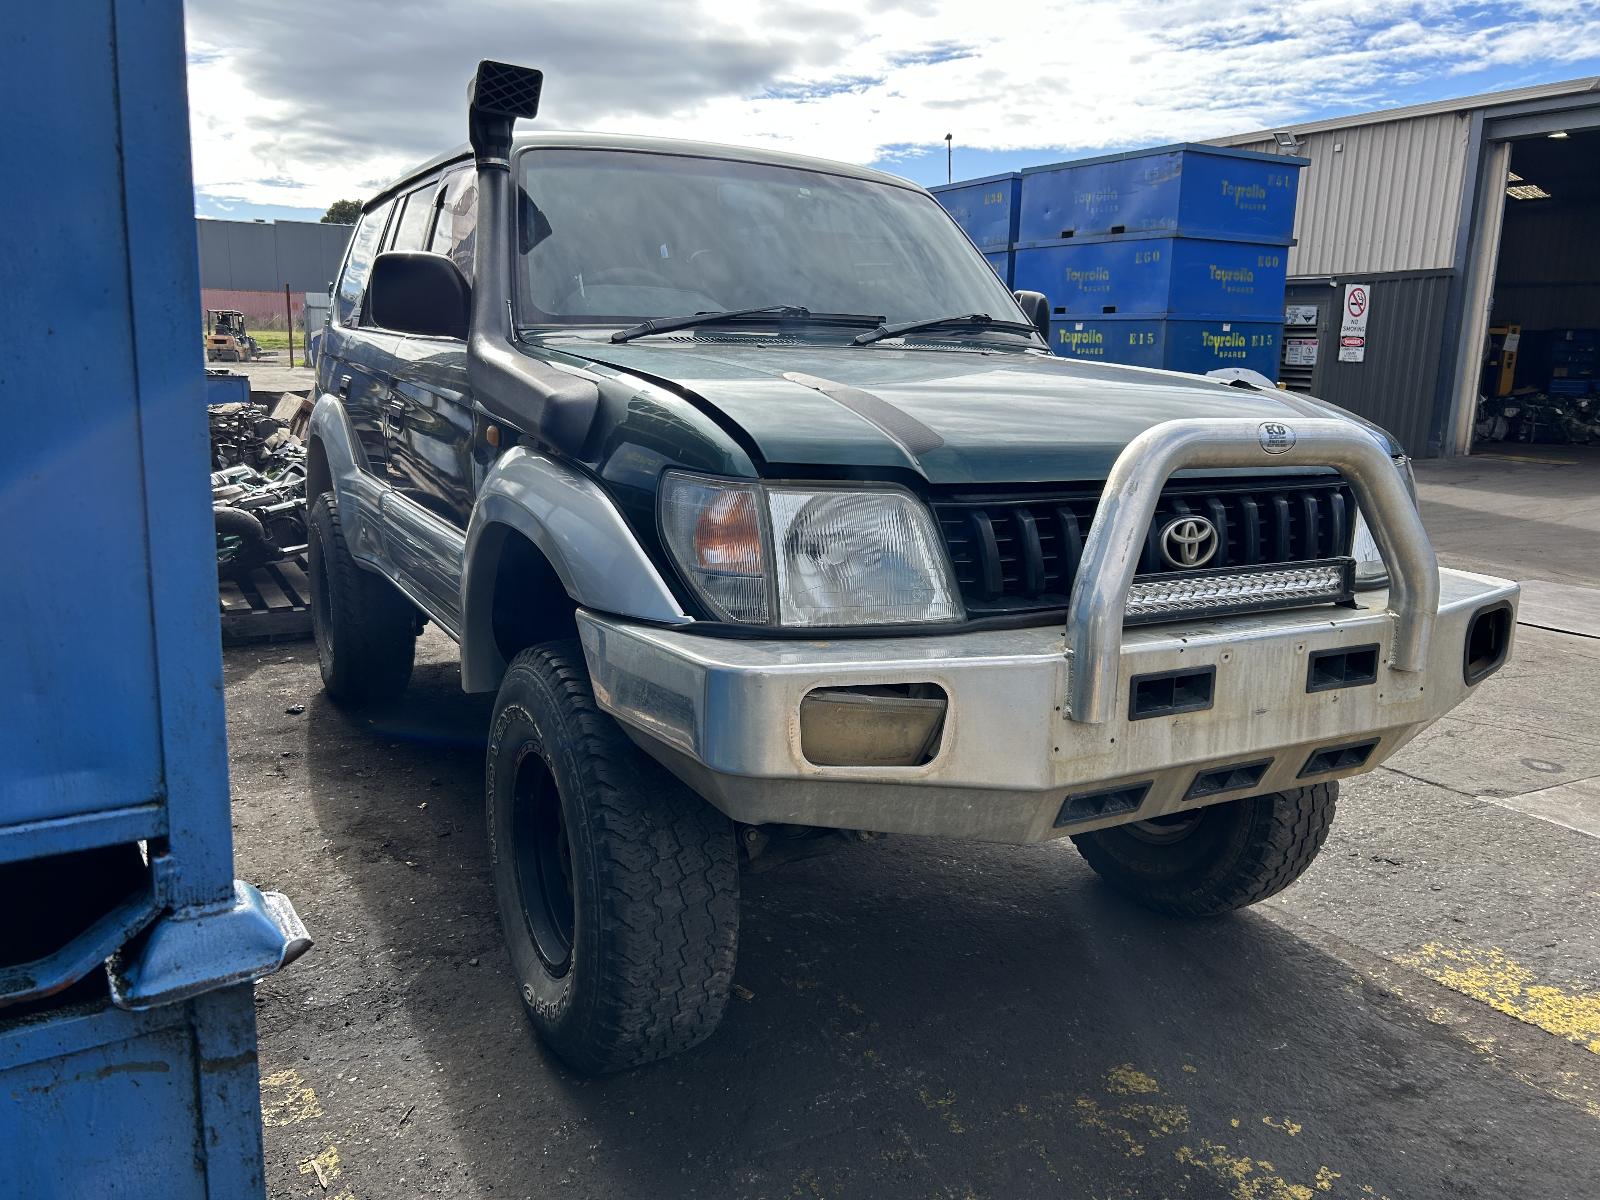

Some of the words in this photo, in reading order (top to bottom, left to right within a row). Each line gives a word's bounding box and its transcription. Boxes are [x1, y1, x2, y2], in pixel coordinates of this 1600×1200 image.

[1221, 179, 1266, 207] Toyrolla
[1135, 250, 1160, 265] E60
[1065, 266, 1110, 290] Toyrolla
[1209, 263, 1254, 289] Toyrolla
[1059, 328, 1103, 352] Toyrolla
[1129, 332, 1154, 345] E15
[1077, 347, 1104, 355] SPARES
[1202, 330, 1246, 355] Toyrolla
[1251, 334, 1273, 347] E15
[1219, 350, 1246, 359] SPARES
[1265, 424, 1287, 435] ECB
